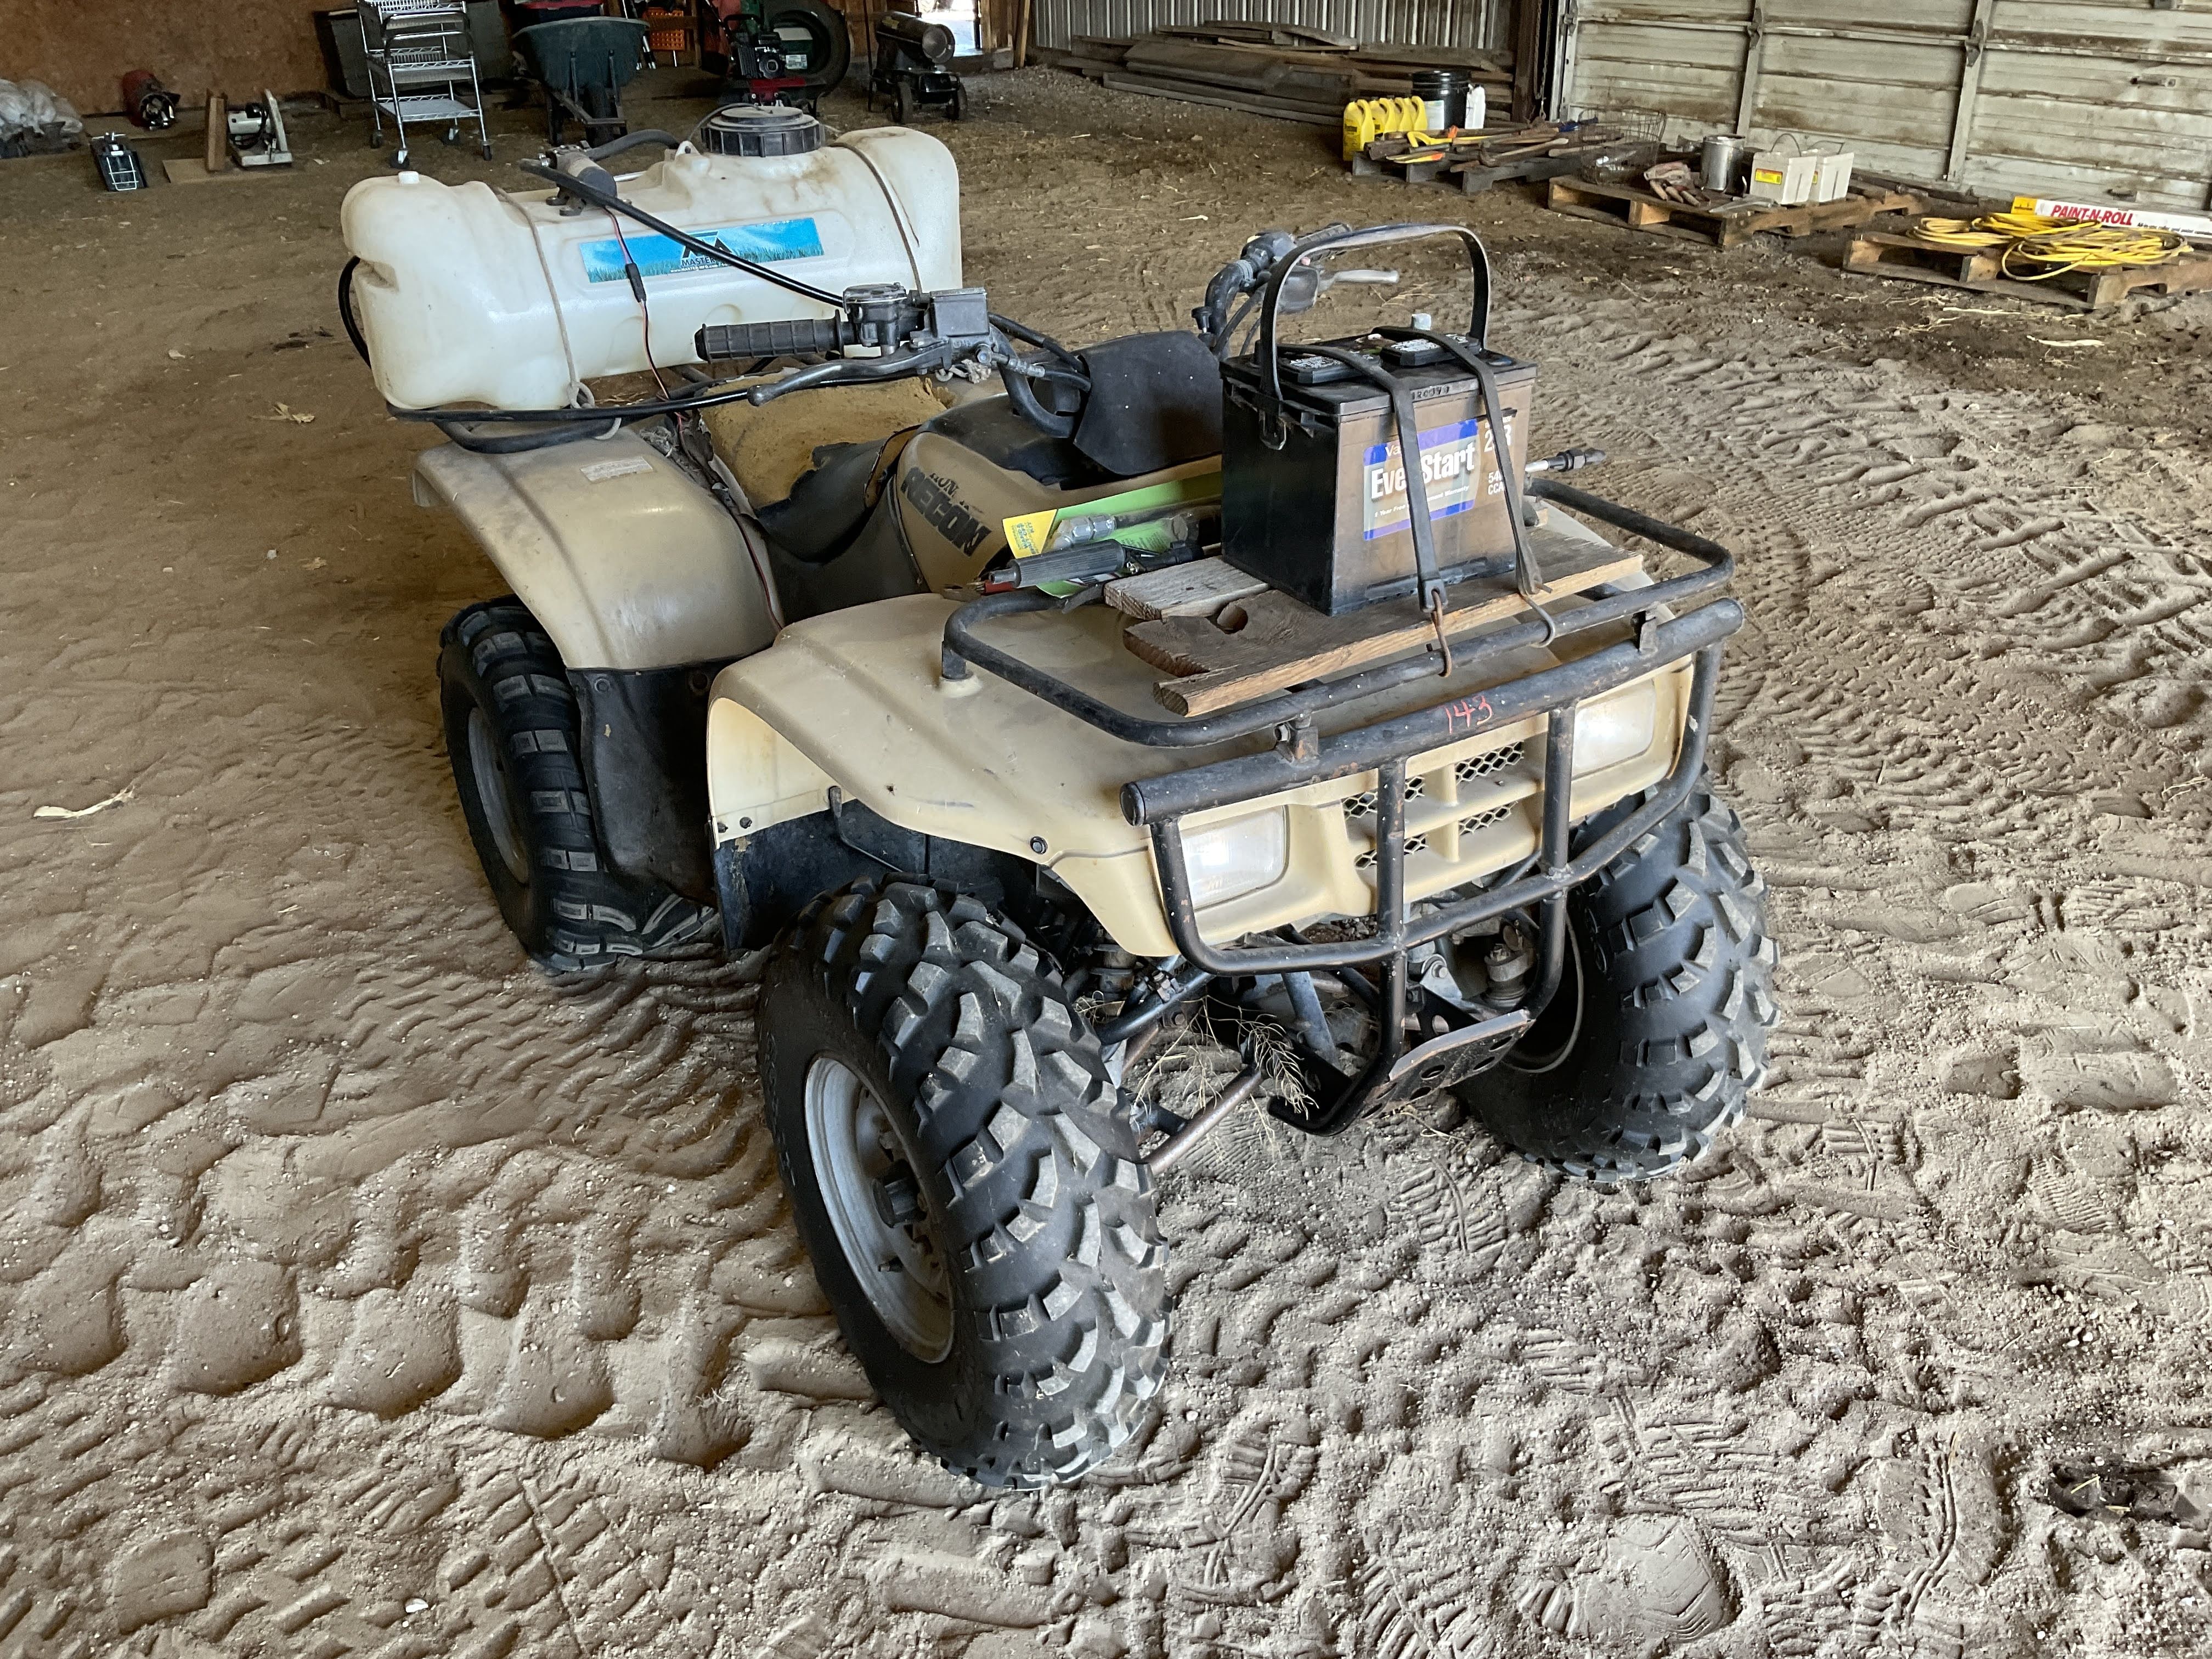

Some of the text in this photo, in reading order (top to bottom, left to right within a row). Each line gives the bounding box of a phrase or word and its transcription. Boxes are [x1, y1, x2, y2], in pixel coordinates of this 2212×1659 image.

[2050, 204, 2134, 225] PAINT-N-ROLL
[682, 256, 715, 267] MASTER
[1371, 442, 1475, 499] EveStart
[1488, 470, 1502, 484] 54
[1488, 481, 1504, 495] CCA
[900, 467, 992, 557] RECON
[1444, 695, 1492, 734] 143
